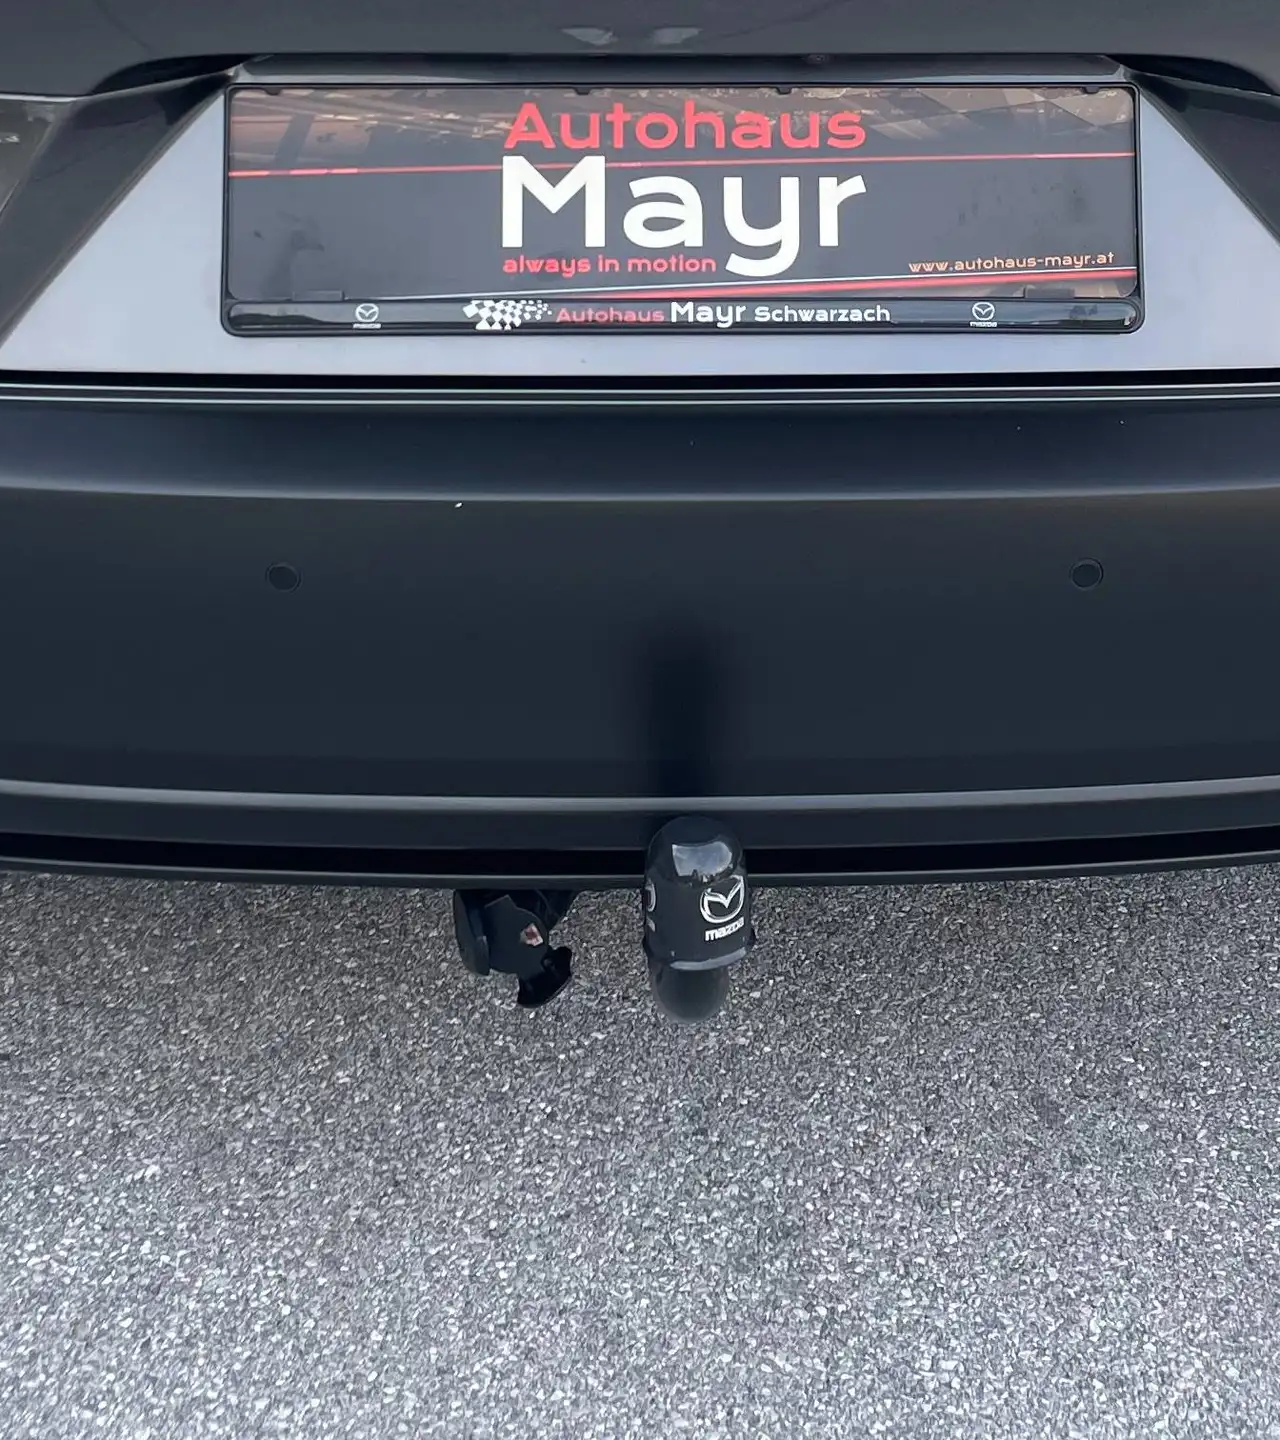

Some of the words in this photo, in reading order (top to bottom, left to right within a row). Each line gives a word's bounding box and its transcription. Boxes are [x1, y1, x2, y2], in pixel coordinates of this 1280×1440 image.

[503, 99, 866, 149] Autohaus
[501, 154, 867, 277] Mayr
[502, 254, 591, 278] always
[597, 253, 620, 273] in
[626, 253, 717, 273] motion
[908, 251, 1115, 273] www.autohaus-mayr.at
[555, 306, 665, 323] Autohaus
[670, 301, 746, 328] Mayr
[754, 304, 891, 323] Schwarzach
